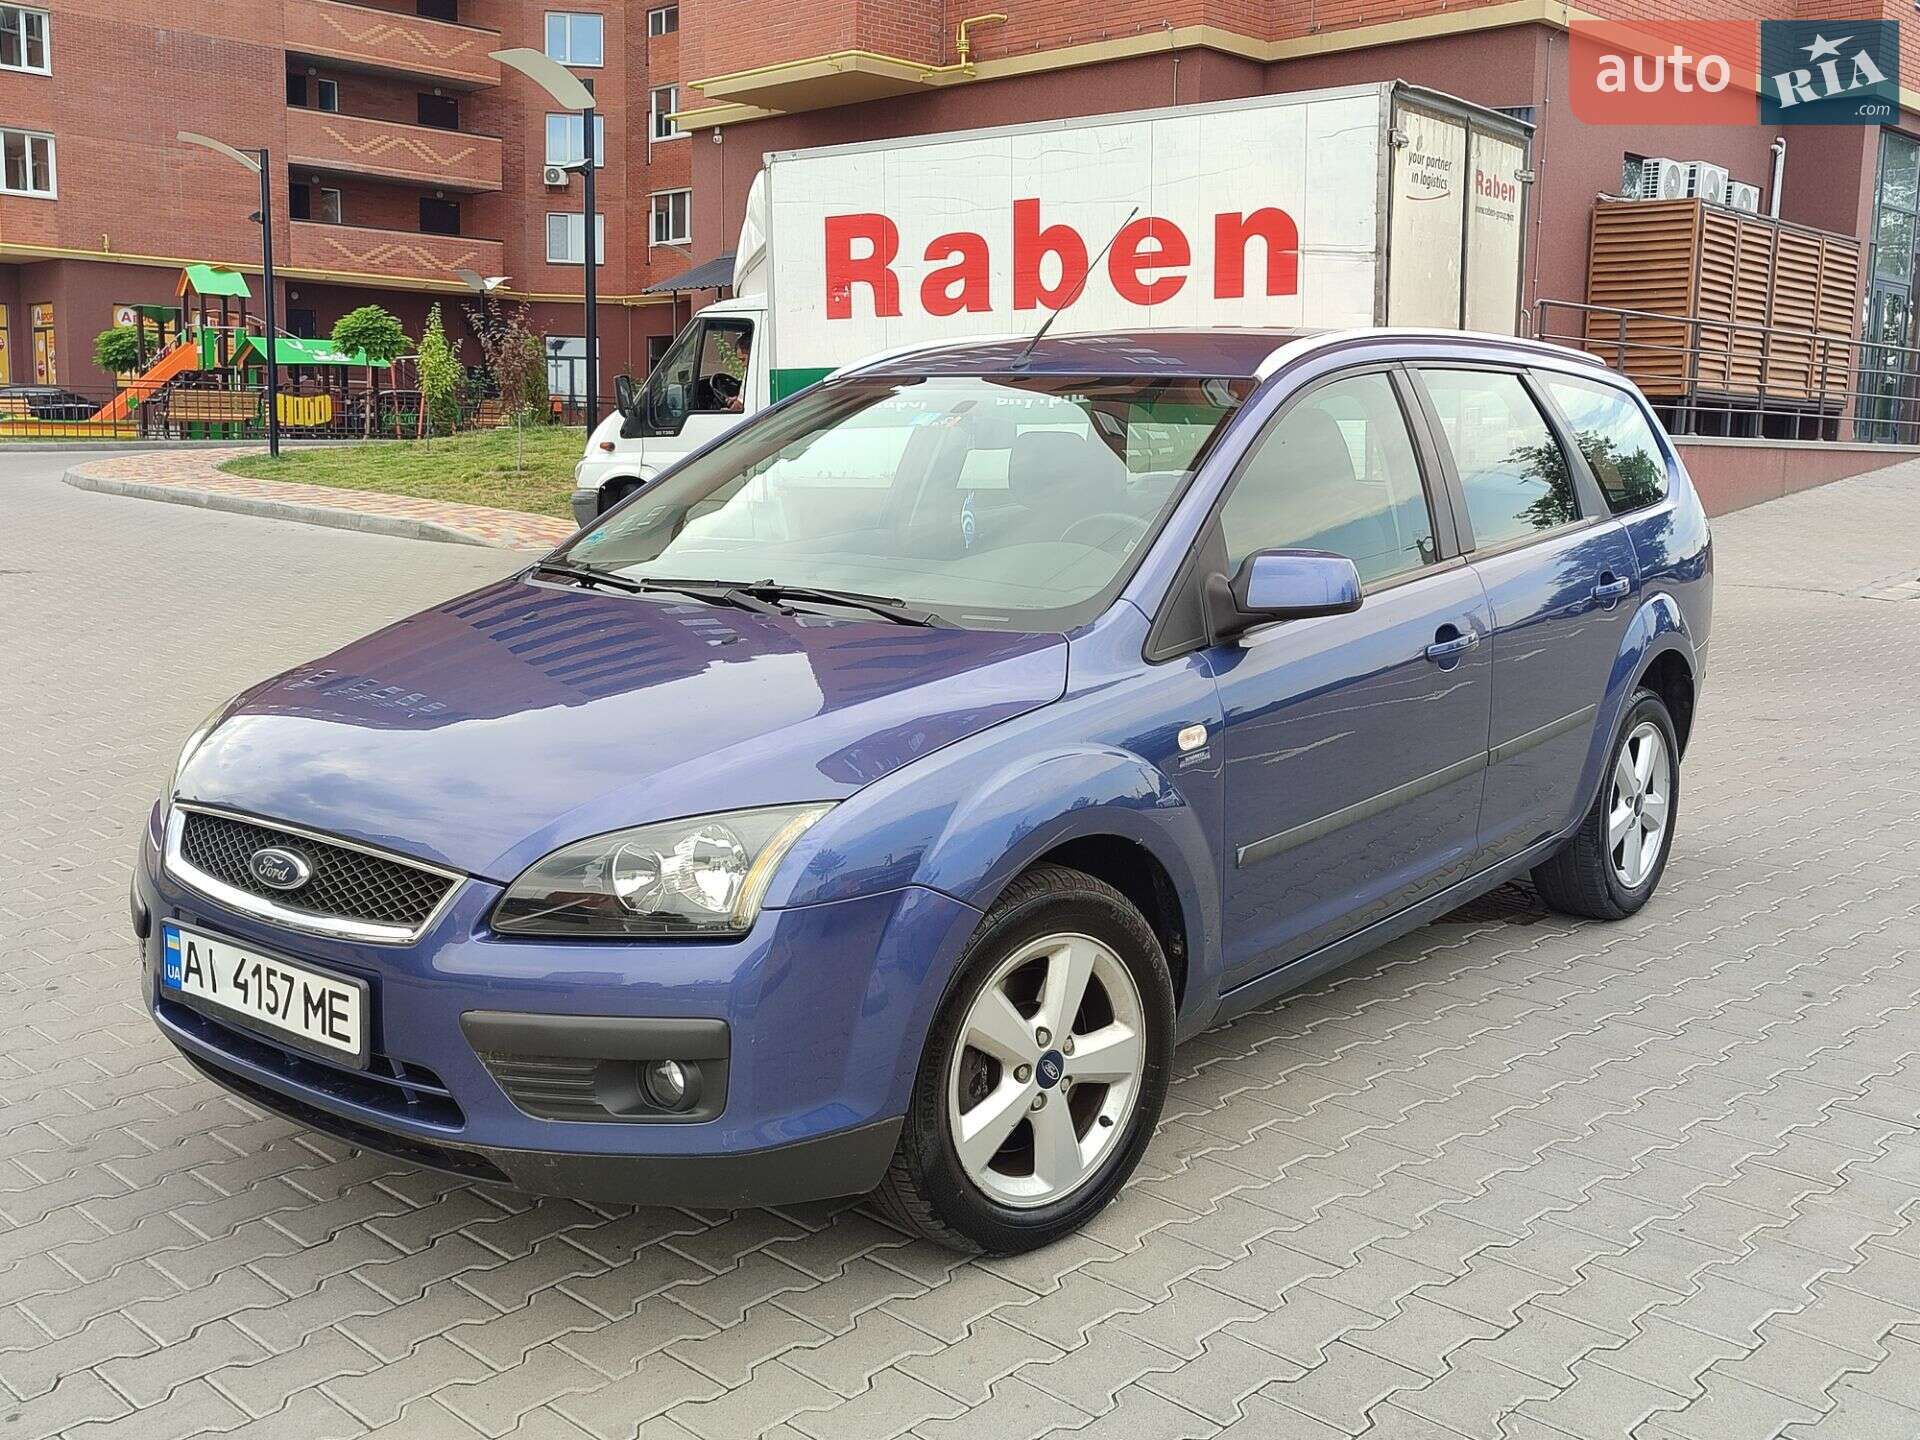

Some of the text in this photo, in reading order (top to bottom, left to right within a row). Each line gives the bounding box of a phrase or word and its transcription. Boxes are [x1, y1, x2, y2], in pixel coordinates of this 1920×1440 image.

[1408, 151, 1452, 171] your partner
[1411, 170, 1448, 190] in logistics
[1475, 168, 1515, 204] Raben
[825, 198, 1299, 320] Raben
[257, 855, 290, 882] Ford
[167, 963, 181, 981] UA
[183, 941, 351, 1044] AI 4157 ME
